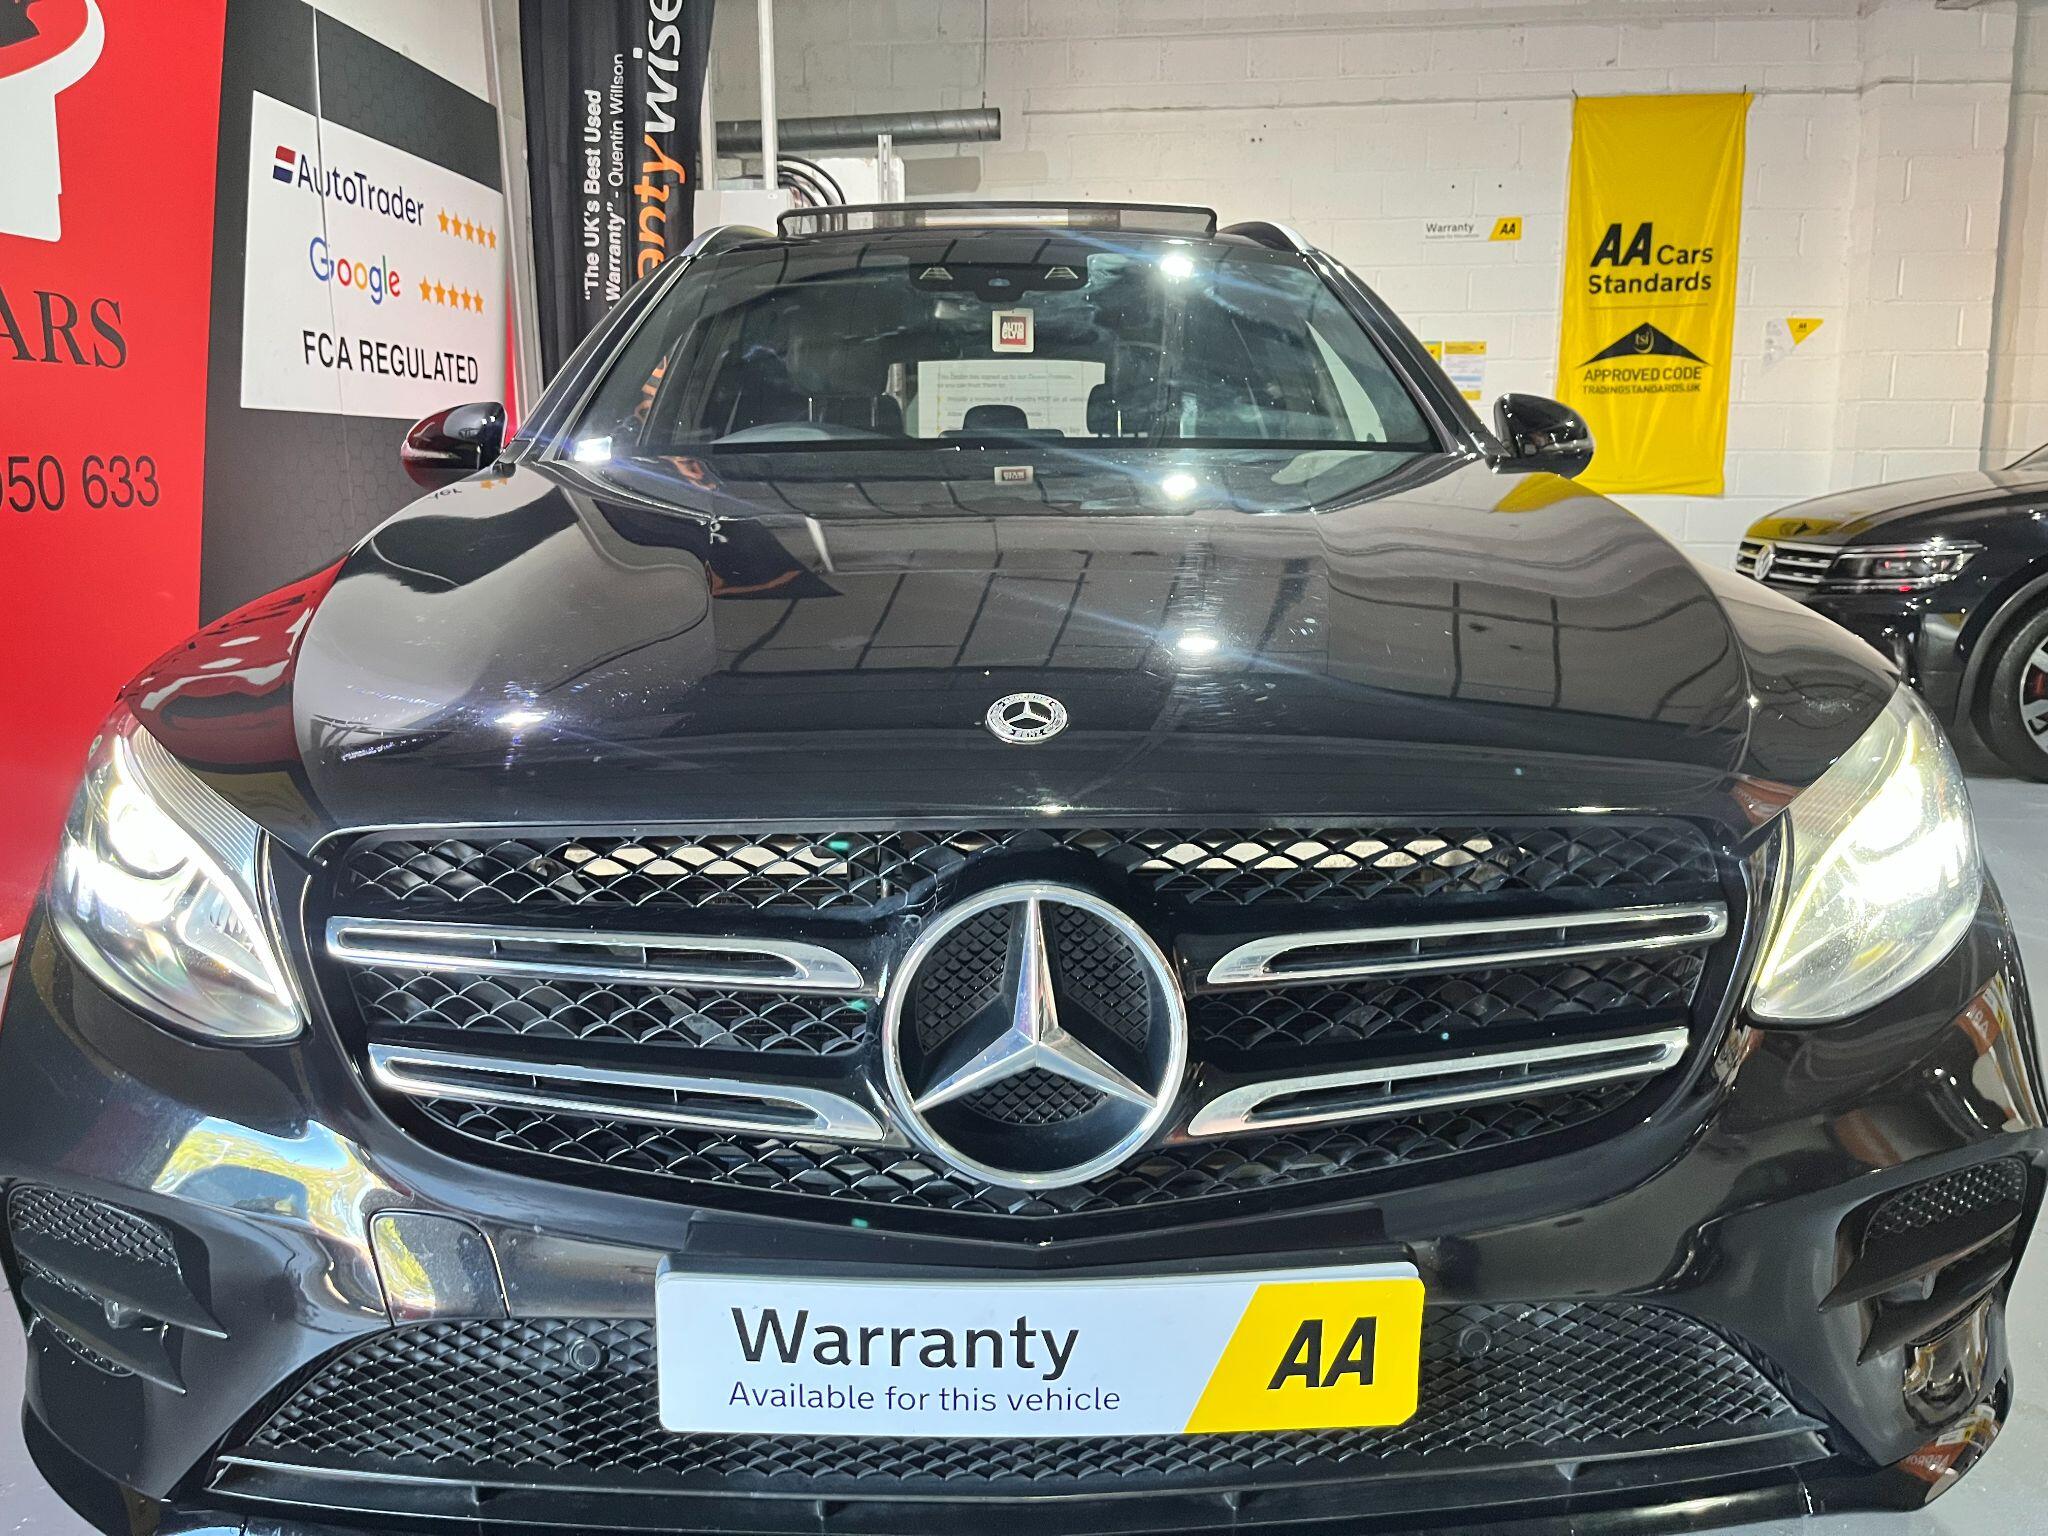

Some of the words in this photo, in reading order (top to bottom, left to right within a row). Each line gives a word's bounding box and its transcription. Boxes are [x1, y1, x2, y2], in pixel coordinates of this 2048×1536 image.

[609, 54, 624, 115] Willson
[584, 90, 602, 143] Used
[584, 149, 601, 194] Best
[608, 121, 625, 187] Quentin
[298, 154, 424, 226] AutoTrader
[583, 201, 600, 247] UK’s
[1426, 223, 1474, 234] Warranty
[1500, 222, 1516, 234] AA
[1590, 222, 1653, 268] AA
[1656, 245, 1713, 265] Cars
[309, 237, 400, 305] Google
[1588, 272, 1712, 295] Standards
[303, 330, 353, 371] FCA
[359, 339, 478, 385] REGULATED
[1584, 368, 1660, 382] APPROVED
[1663, 366, 1701, 380] CODE
[1582, 383, 1701, 395] TRADINGSTANDARDS.UK
[0, 455, 65, 512] 50
[82, 455, 160, 510] 633
[731, 1307, 1080, 1380] Warranty
[1267, 1316, 1378, 1390] AA
[728, 1381, 874, 1411] Available
[882, 1383, 933, 1411] for
[938, 1386, 998, 1412] this
[1006, 1386, 1121, 1412] vehicle
